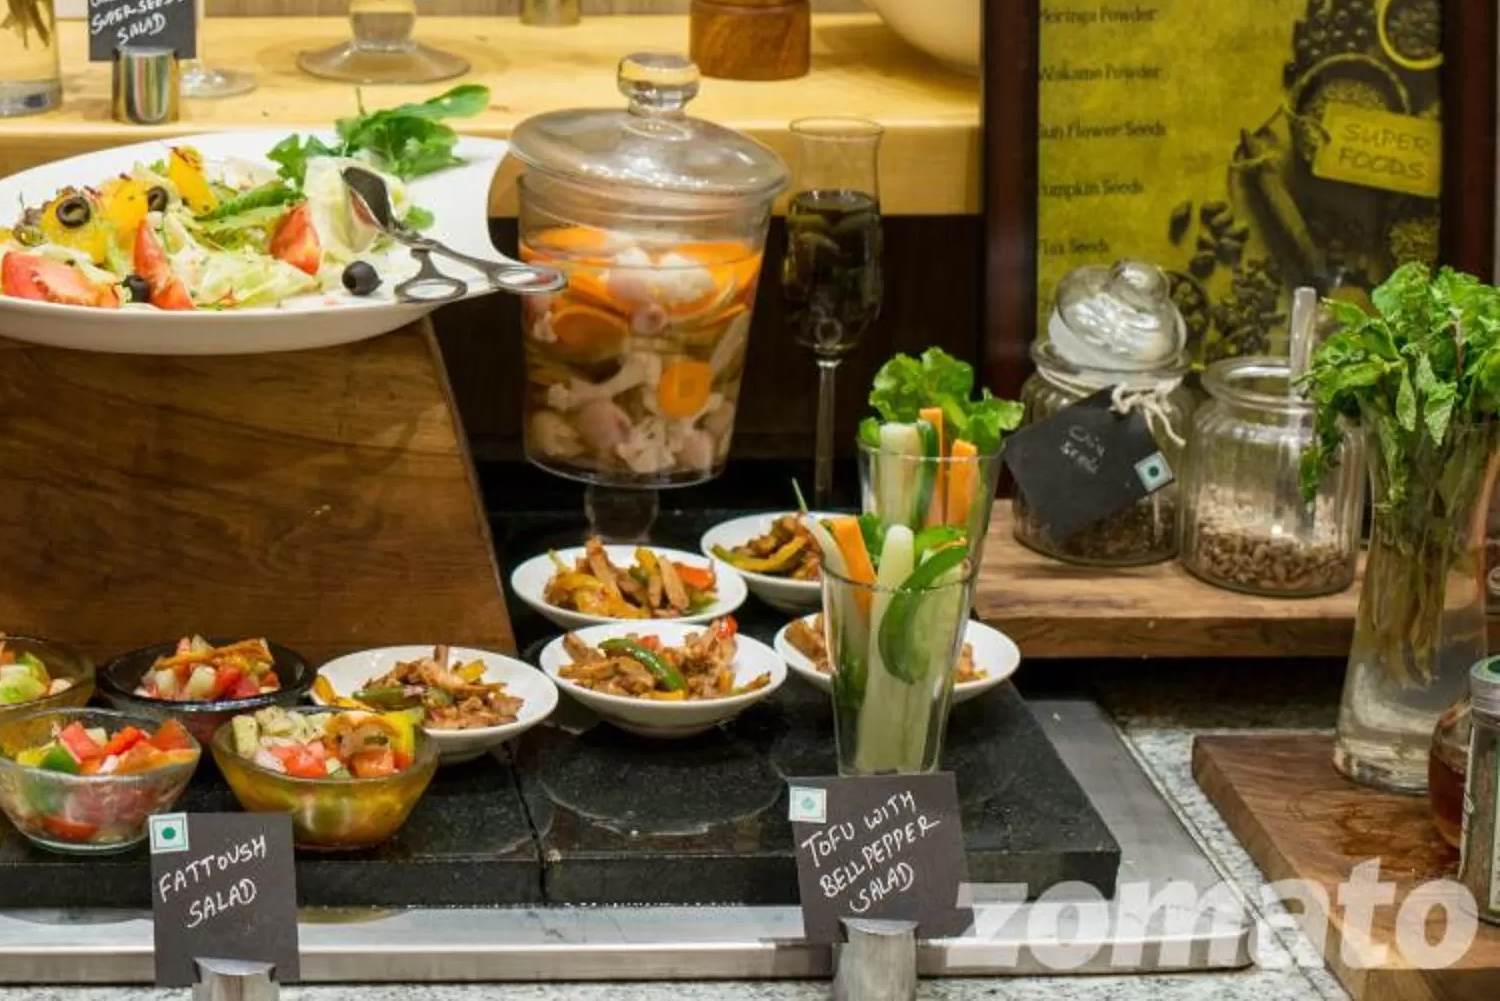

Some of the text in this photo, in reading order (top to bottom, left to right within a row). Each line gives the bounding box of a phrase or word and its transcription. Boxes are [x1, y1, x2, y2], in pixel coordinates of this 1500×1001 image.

[1340, 122, 1433, 153] SUPER
[1338, 146, 1428, 181] FOODS
[801, 790, 917, 869] TOFU WITH
[158, 834, 267, 904] FATTOUSH
[849, 862, 914, 913] SALAD
[187, 878, 257, 929] SALAD
